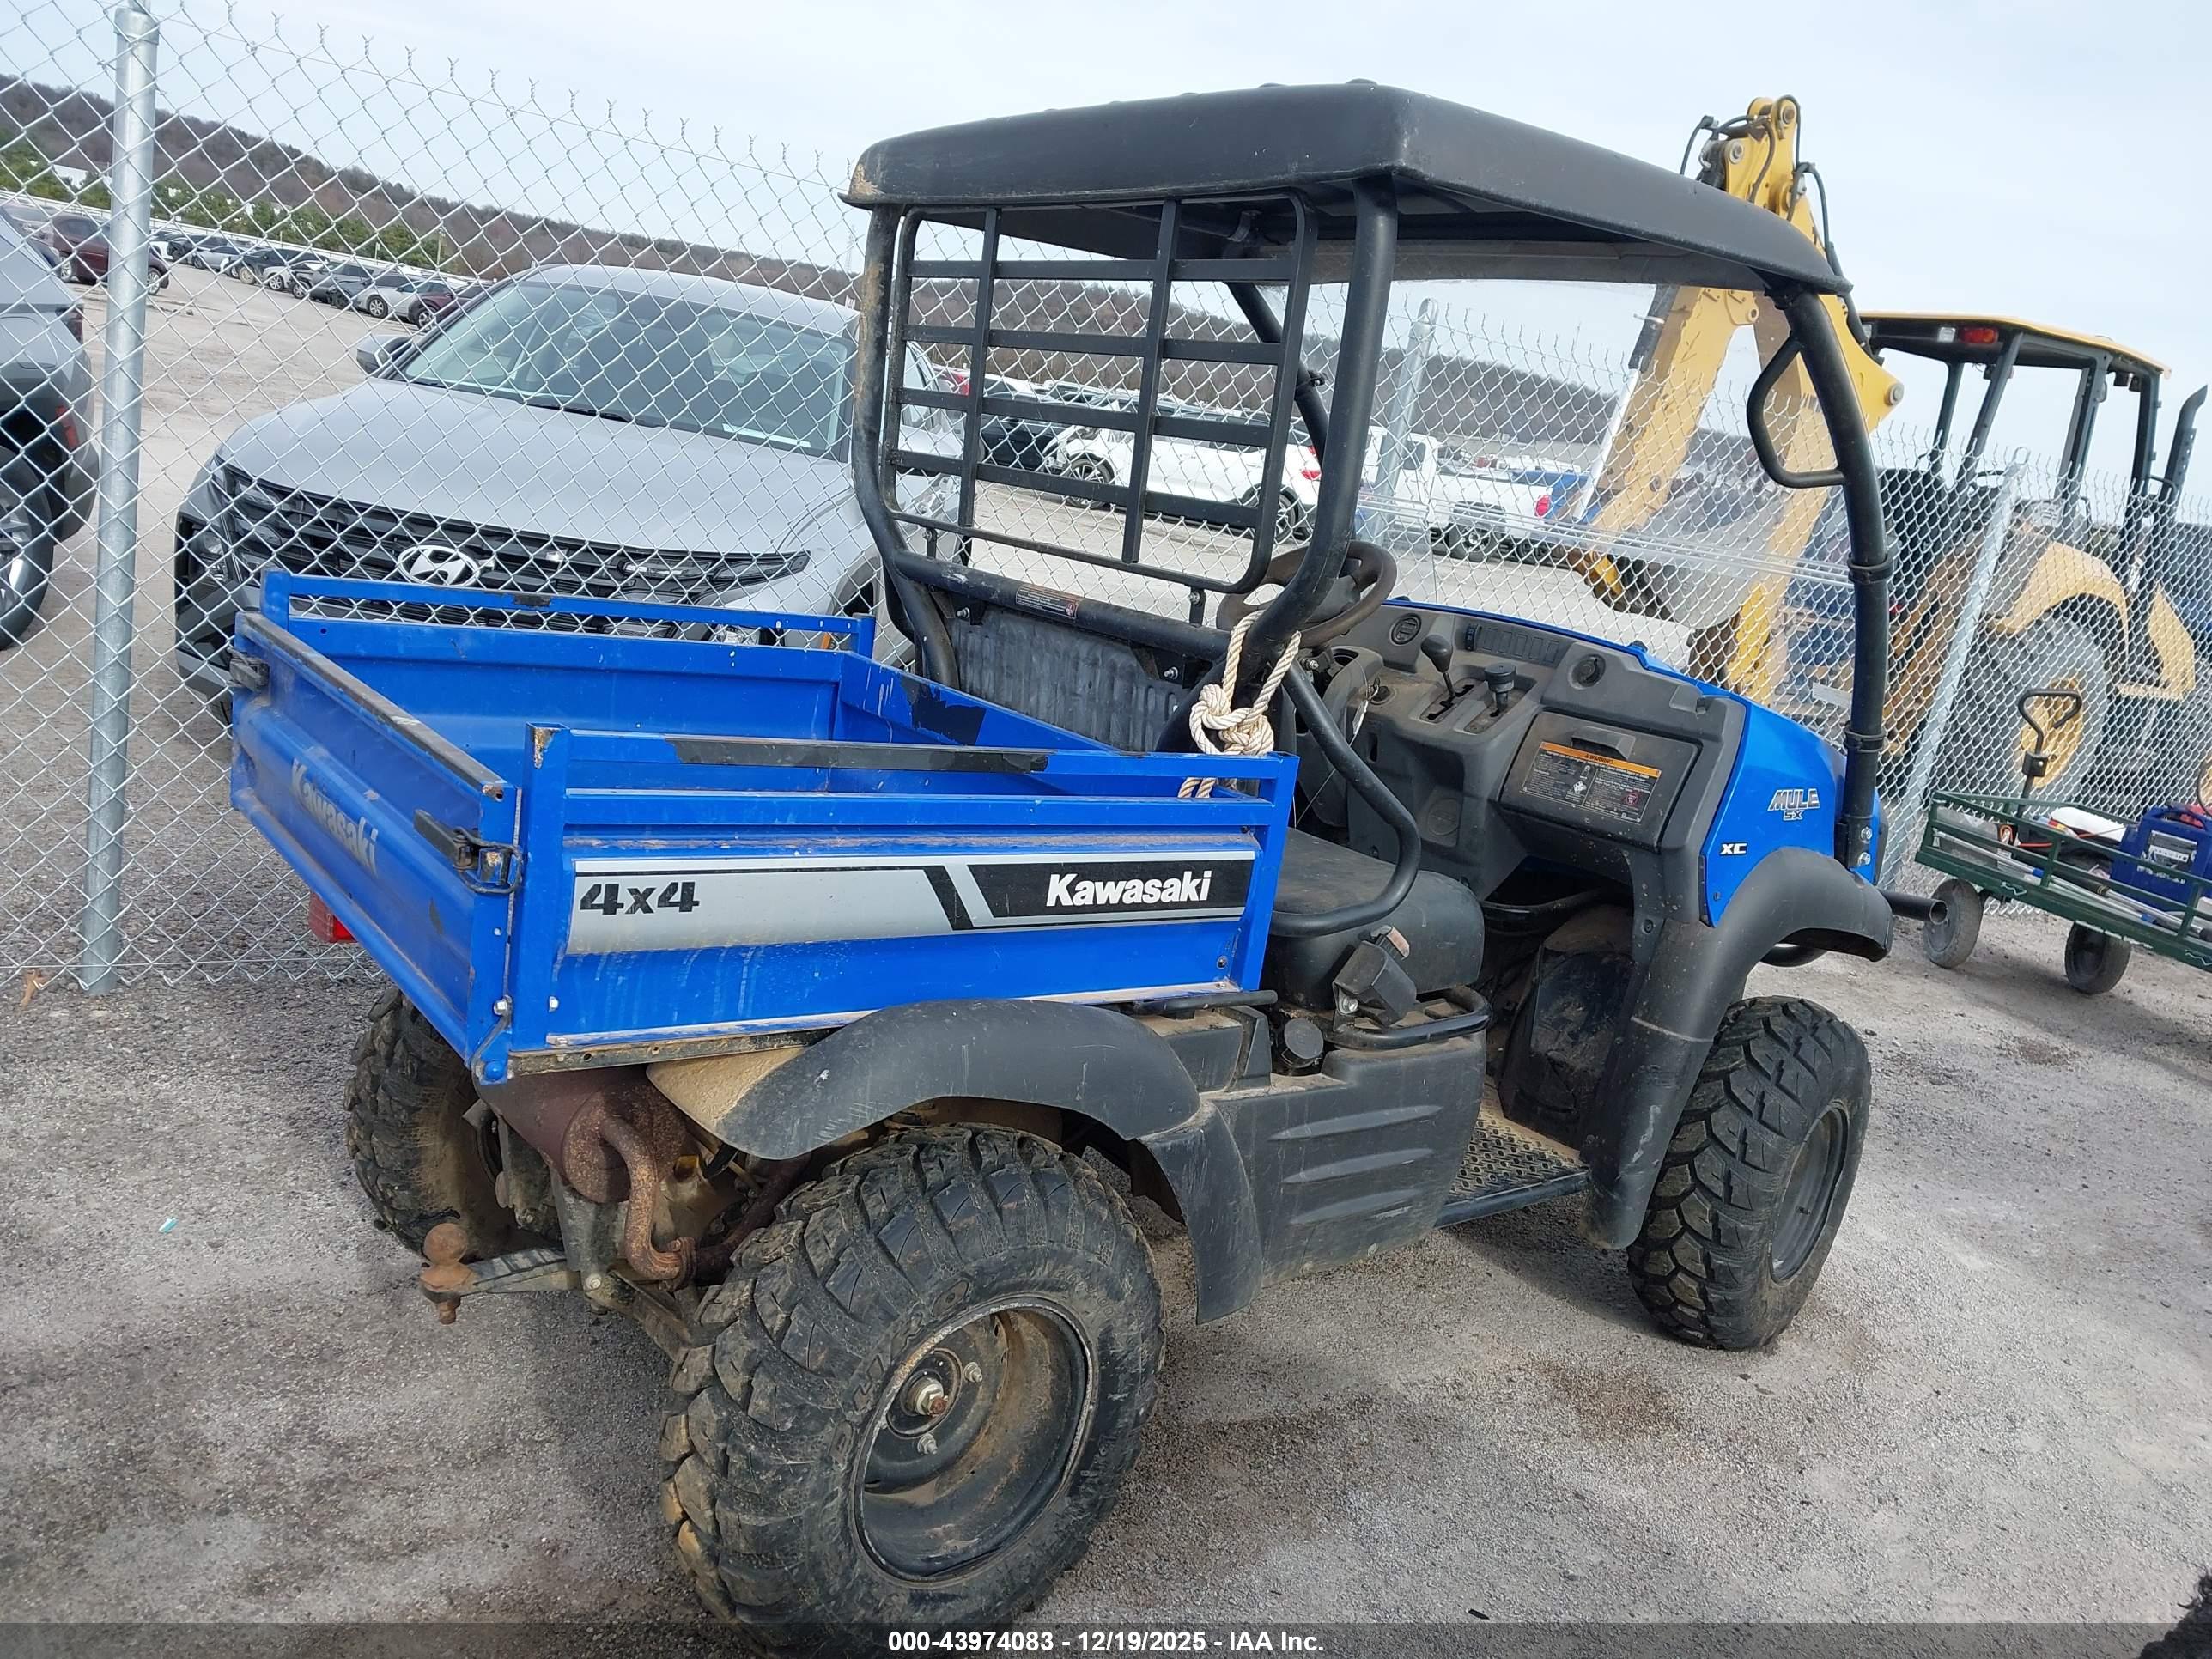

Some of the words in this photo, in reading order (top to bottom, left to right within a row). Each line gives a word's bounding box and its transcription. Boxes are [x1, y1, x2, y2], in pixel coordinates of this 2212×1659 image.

[1767, 788, 1820, 811] MULE
[289, 757, 379, 878] Kawasaki
[1783, 809, 1803, 821] SX
[1720, 842, 1748, 855] XC
[580, 881, 700, 915] 4x4
[1046, 870, 1212, 907] Kawasaki
